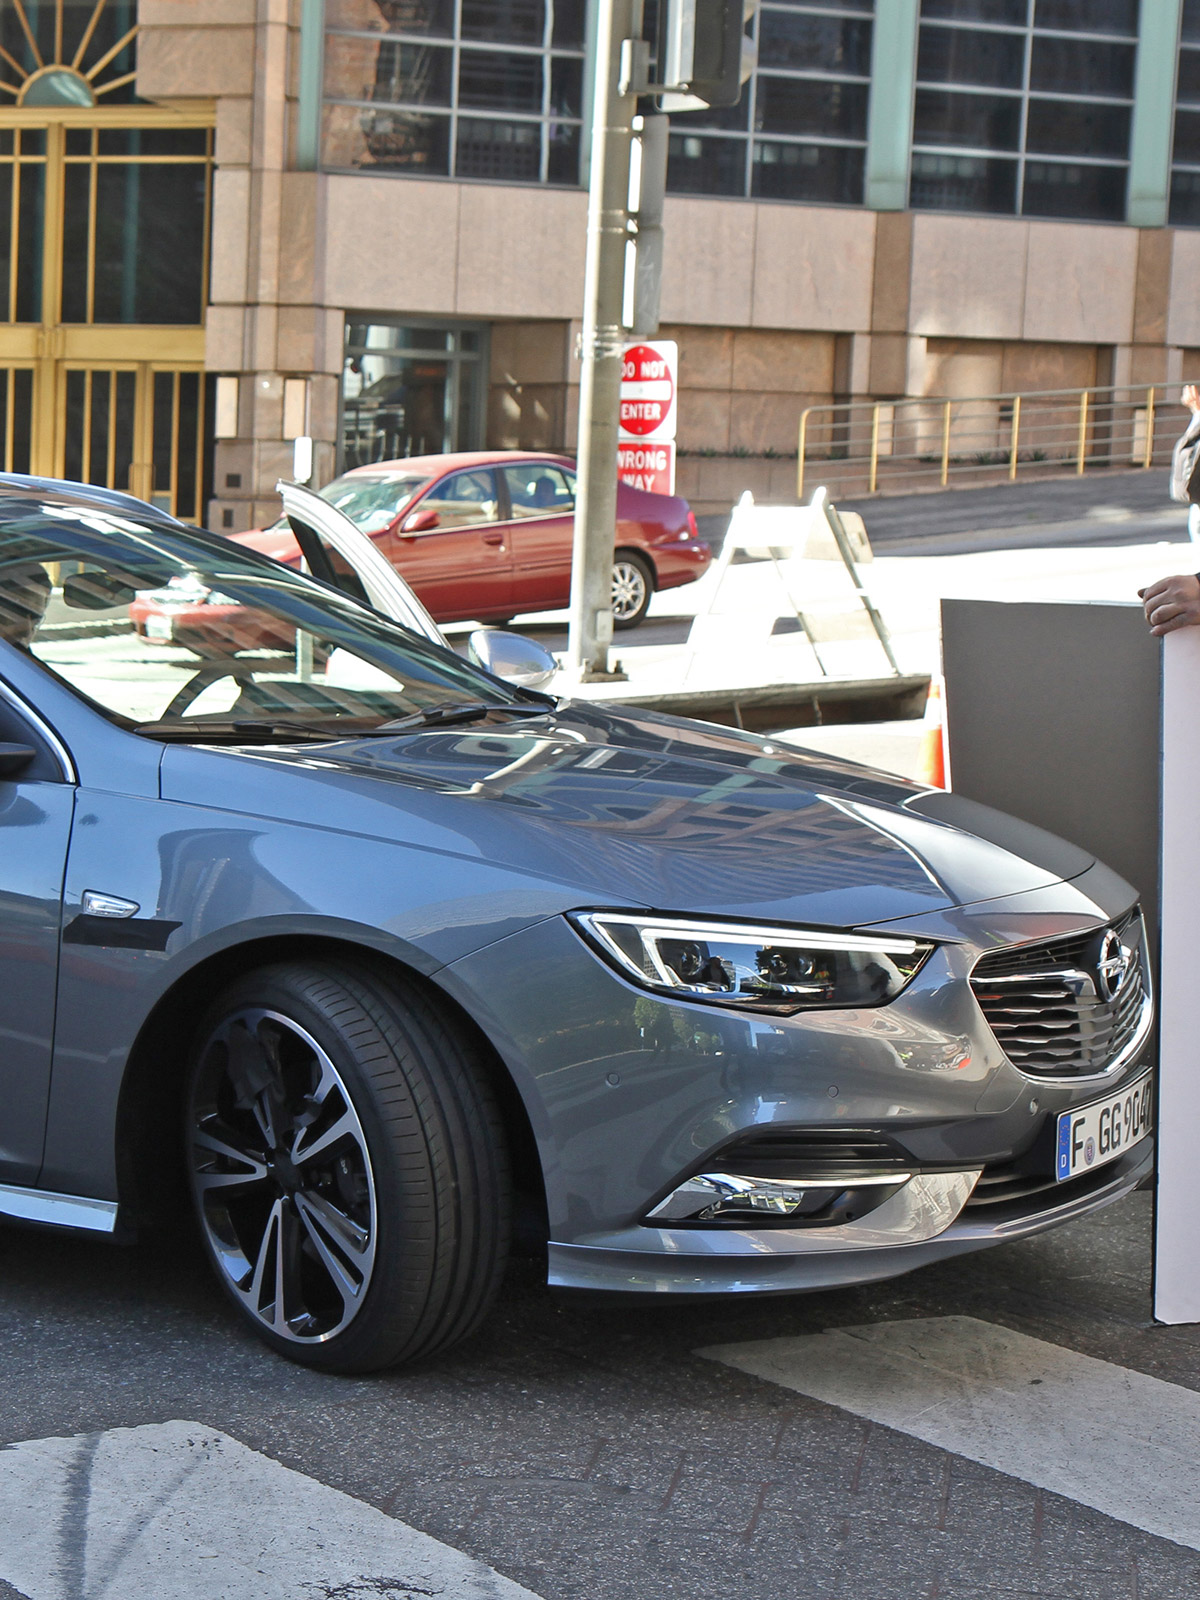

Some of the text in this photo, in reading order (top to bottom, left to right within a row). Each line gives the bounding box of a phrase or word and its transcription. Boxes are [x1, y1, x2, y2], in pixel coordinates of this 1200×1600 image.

[641, 361, 665, 378] NOT
[621, 404, 660, 420] ENTER
[1072, 1116, 1086, 1168] F
[1099, 1102, 1121, 1155] GG
[1061, 1154, 1067, 1168] D
